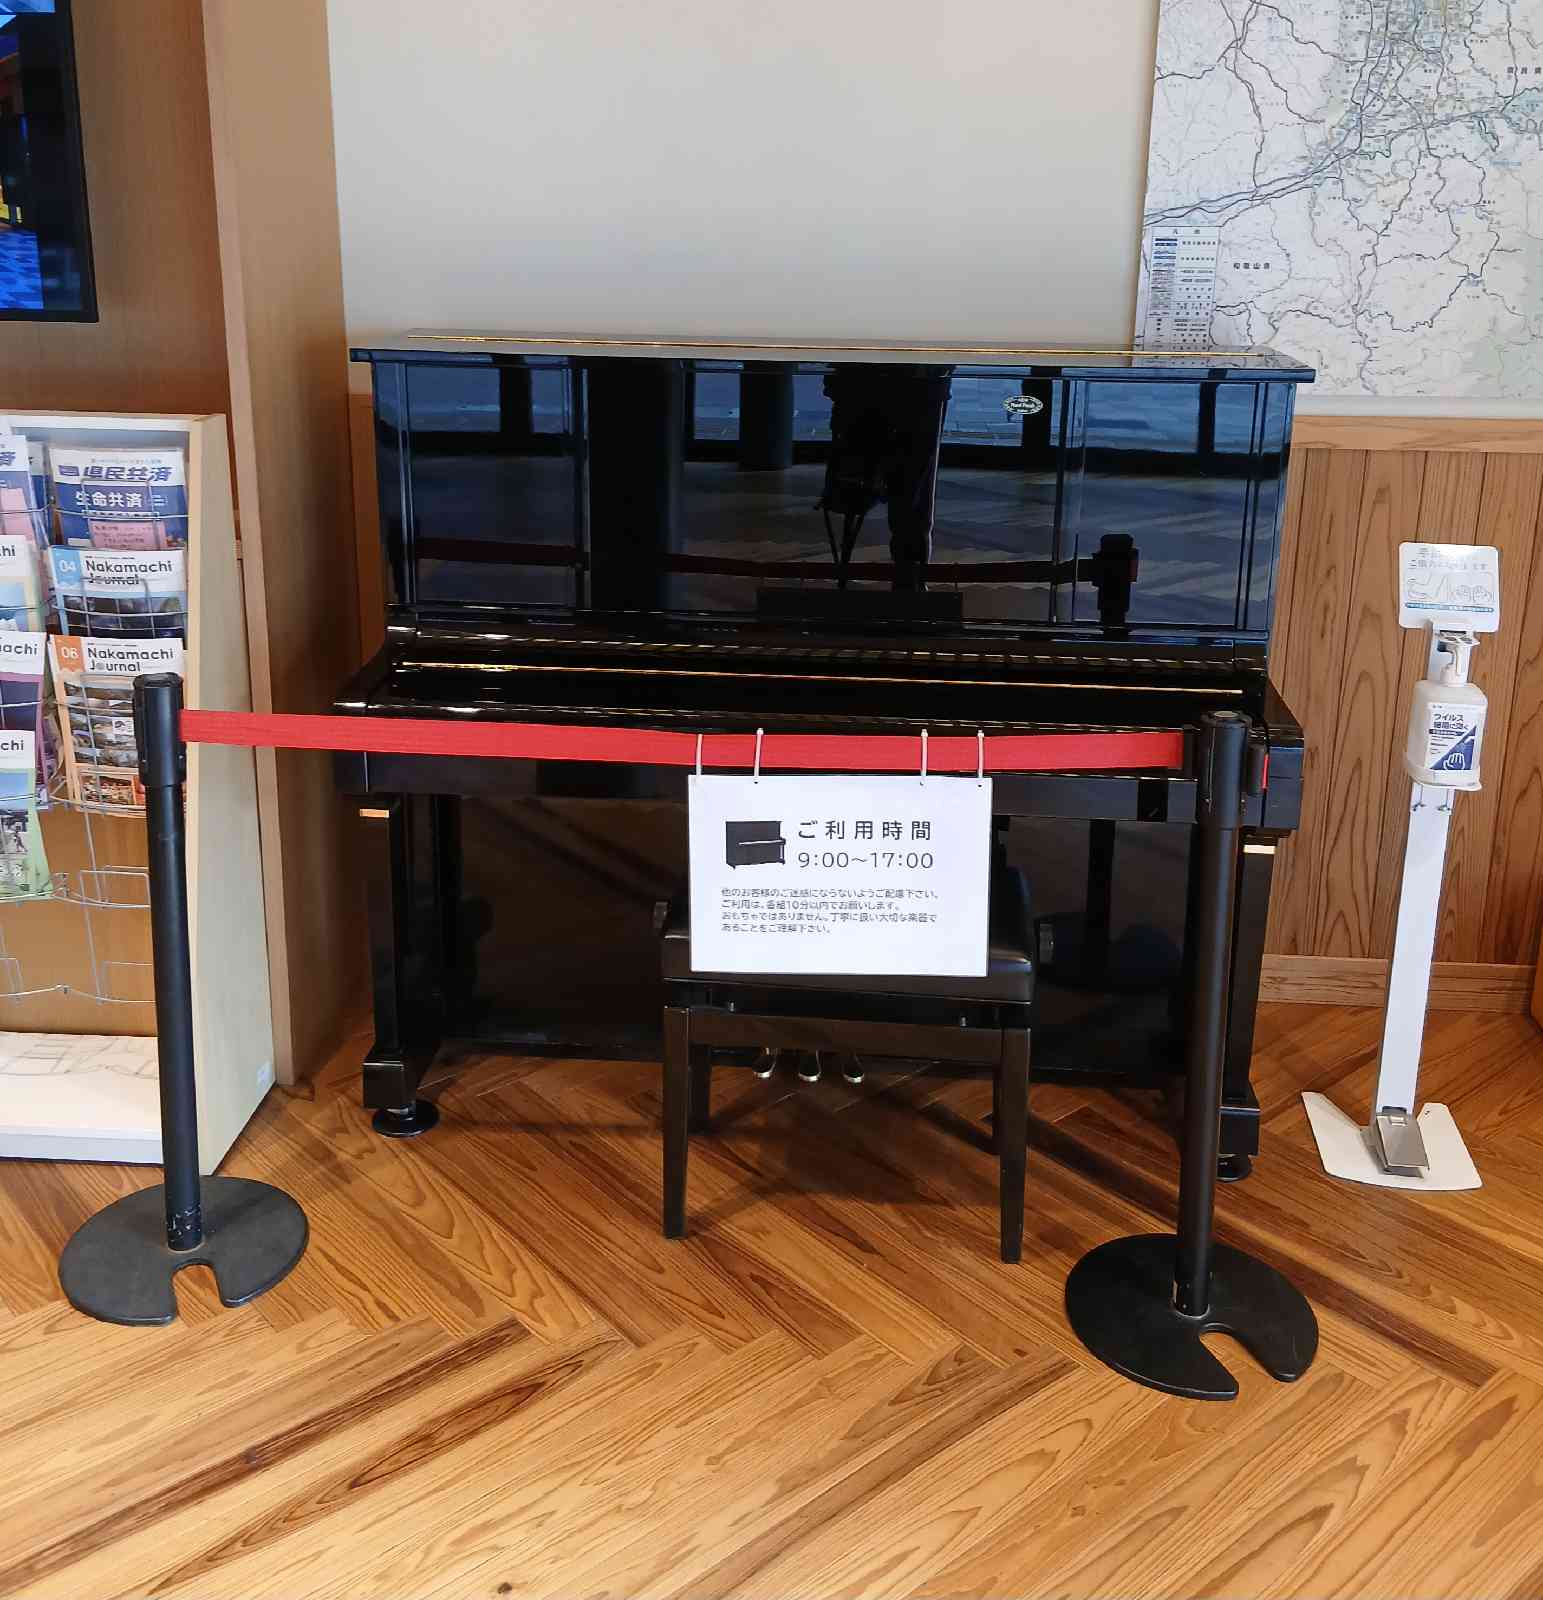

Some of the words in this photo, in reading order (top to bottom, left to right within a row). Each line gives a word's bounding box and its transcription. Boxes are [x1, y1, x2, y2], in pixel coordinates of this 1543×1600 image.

[75, 491, 142, 508] 生命共済
[0, 544, 16, 557] hi
[86, 559, 173, 573] Nakamachi
[0, 643, 38, 655] achi
[61, 647, 79, 660] 06
[87, 647, 174, 660] Nakamachi
[89, 660, 141, 672] Journal
[797, 820, 932, 841] ご利用時間
